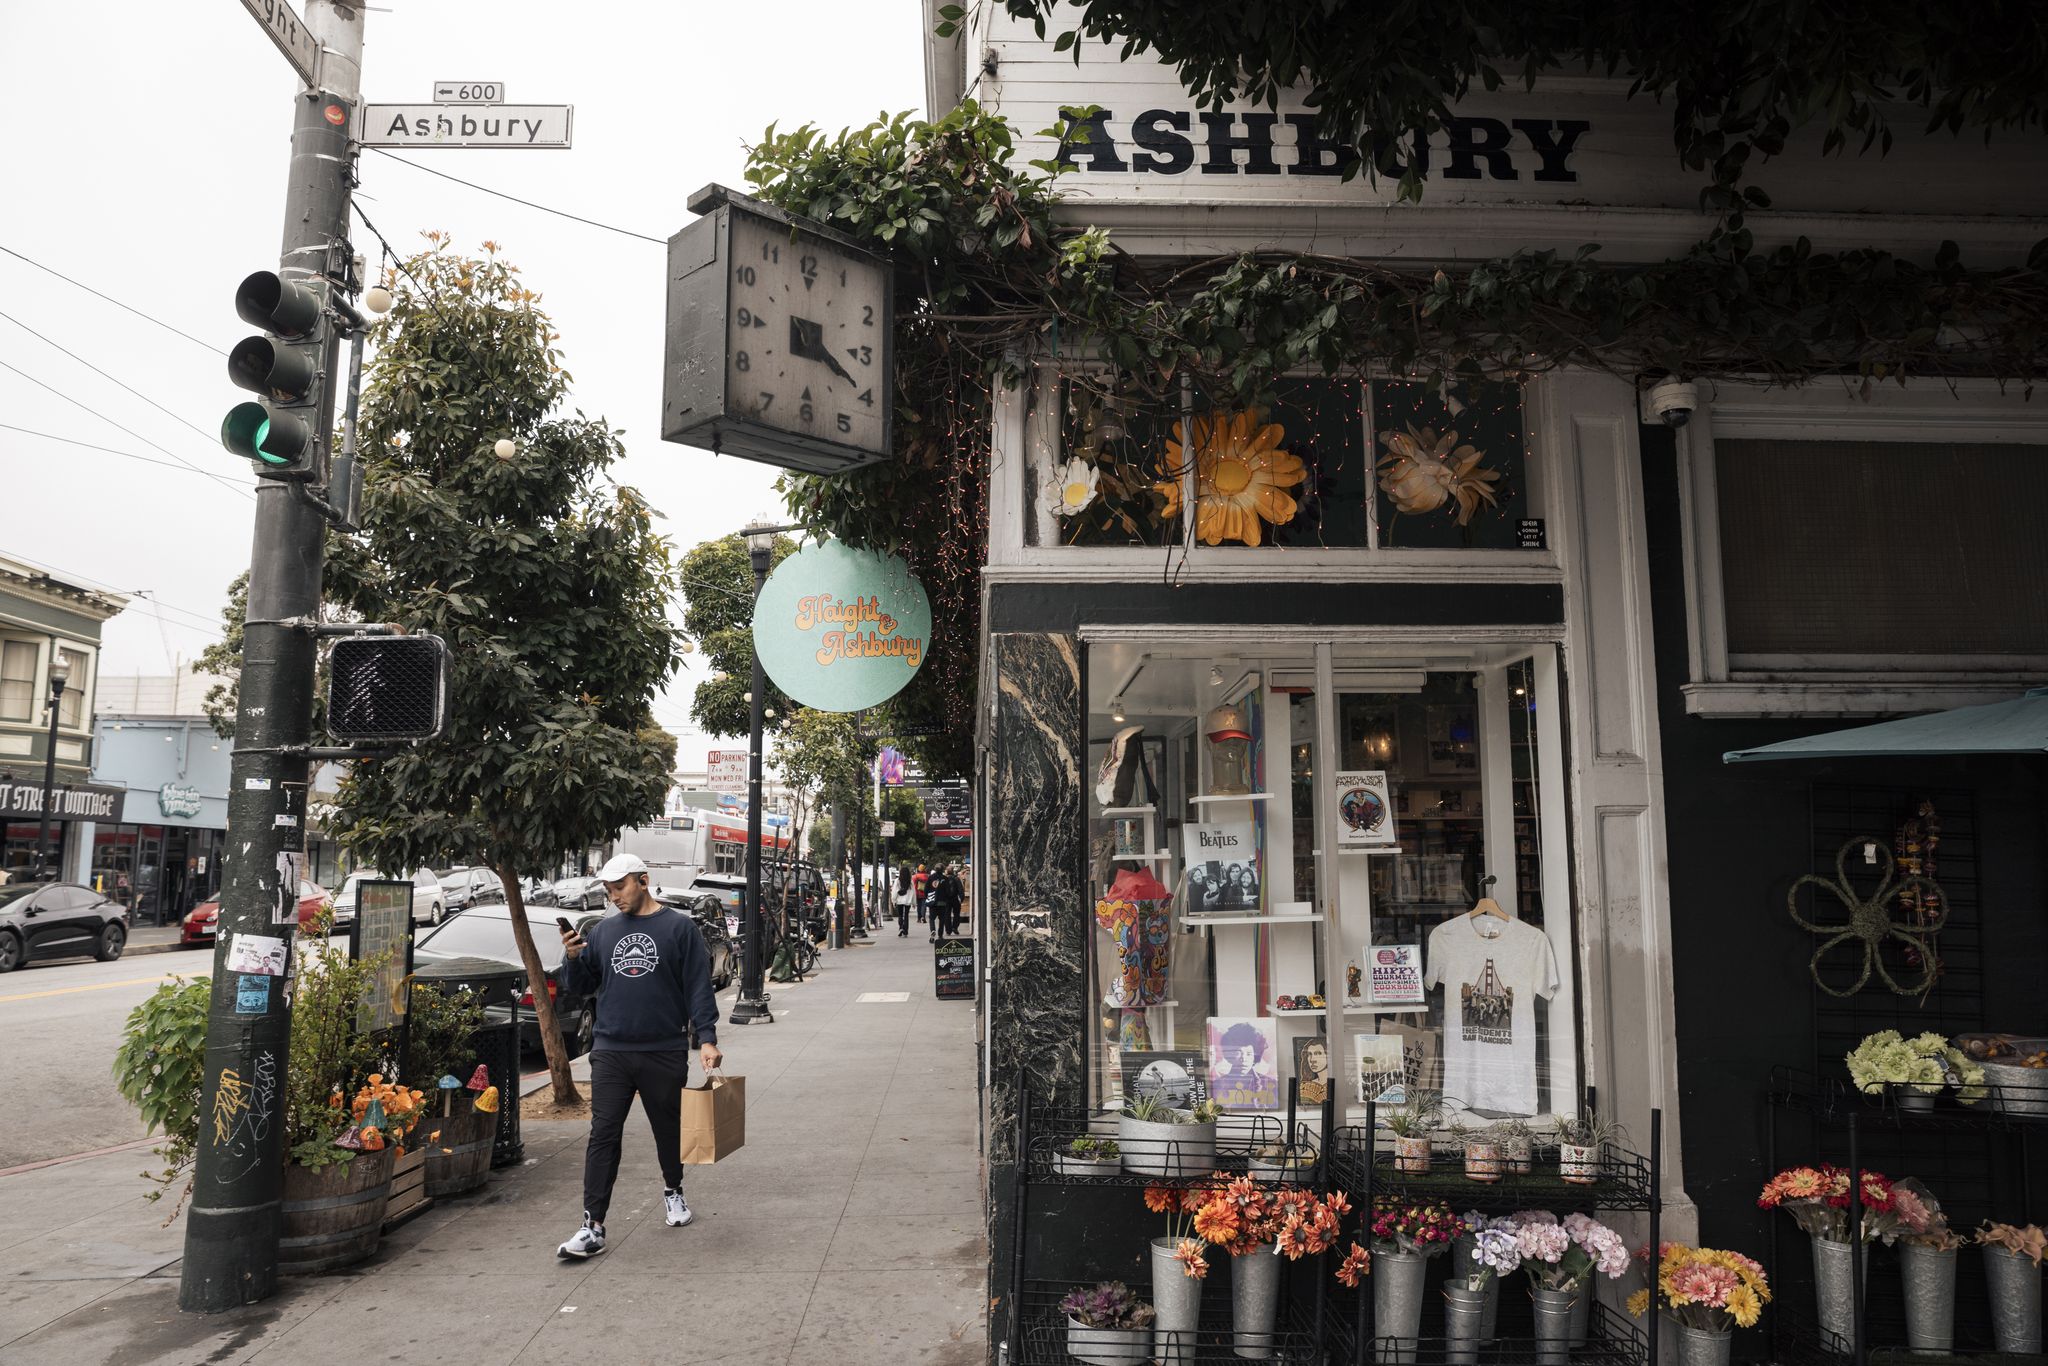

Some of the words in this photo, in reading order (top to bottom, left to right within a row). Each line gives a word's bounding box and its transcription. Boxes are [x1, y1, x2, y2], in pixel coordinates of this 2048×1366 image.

[262, 0, 297, 46] ght
[459, 85, 496, 100] 600
[386, 114, 543, 143] Ashbury
[1058, 108, 1591, 183] ASHBURY
[761, 241, 779, 264] 11
[735, 264, 756, 287] 10
[800, 255, 818, 278] 12
[839, 269, 847, 288] 1
[737, 307, 751, 328] 9
[862, 305, 873, 326] 2
[735, 351, 750, 372] 8
[859, 345, 872, 366] 3
[759, 391, 775, 411] 7
[857, 388, 874, 408] 4
[800, 403, 813, 423] 6
[836, 413, 851, 433] 5
[795, 593, 882, 633] Haight
[878, 614, 898, 635] &
[815, 631, 922, 667] Ashbury
[709, 751, 720, 763] NO
[721, 753, 746, 762] PARKING
[13, 786, 64, 813] STRET
[64, 790, 115, 817] VINTAGE
[164, 799, 202, 815] vintage
[1200, 831, 1239, 848] BEATLES
[616, 936, 654, 955] WHISTLER
[617, 960, 652, 970] BLACKCOMB
[1372, 967, 1419, 975] HIPPY
[1478, 1034, 1512, 1045] FRANCISCO
[1185, 1057, 1194, 1076] THE
[1187, 1076, 1196, 1090] ME
